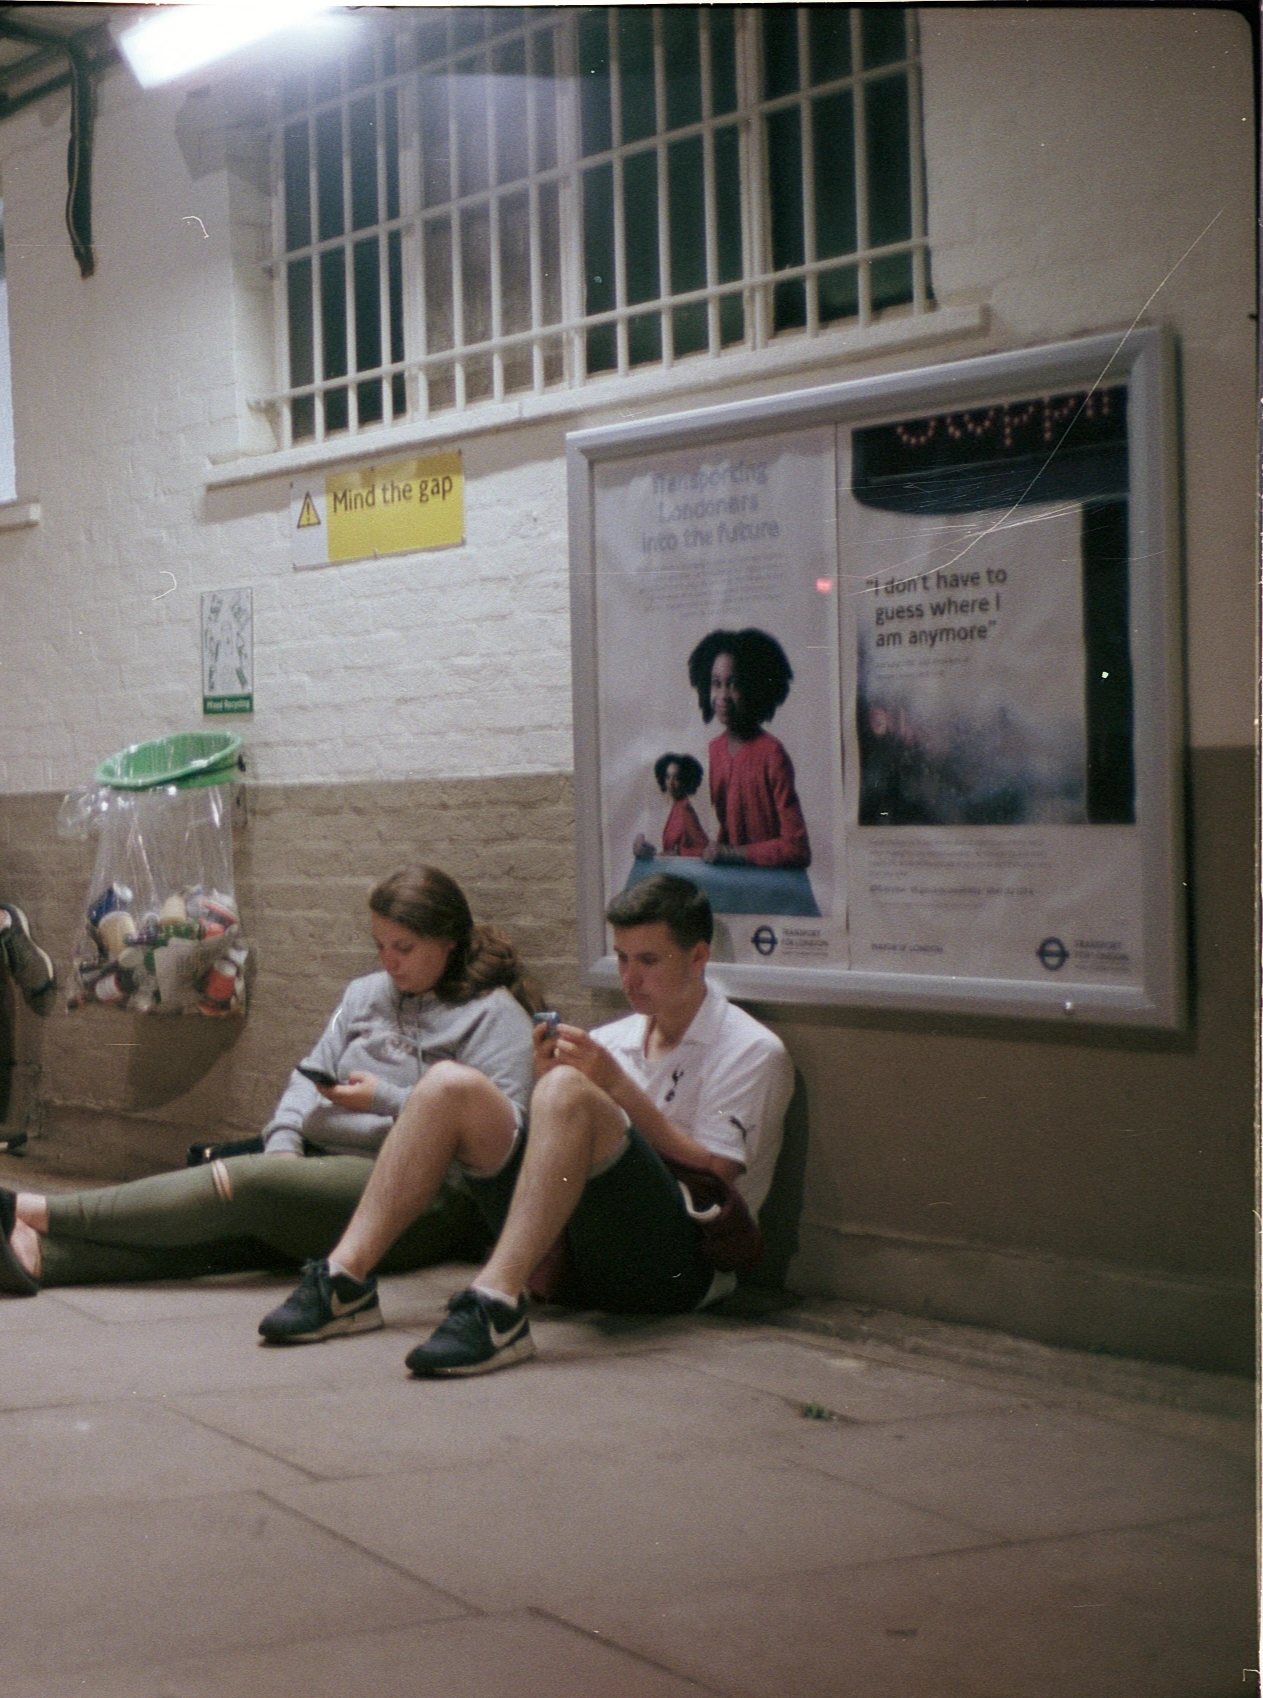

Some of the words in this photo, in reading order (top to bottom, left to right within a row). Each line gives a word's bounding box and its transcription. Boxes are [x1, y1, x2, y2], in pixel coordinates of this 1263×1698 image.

[333, 484, 376, 513] Mind
[382, 480, 413, 504] the
[419, 475, 453, 504] gap
[659, 494, 758, 523] Londoners
[642, 532, 679, 553] into
[683, 526, 713, 548] the
[718, 520, 779, 543] future
[884, 573, 930, 595] don't
[936, 571, 981, 589] have
[986, 568, 1008, 585] to
[875, 602, 924, 626] guess
[930, 597, 990, 617] where
[995, 593, 1001, 611] I
[876, 631, 902, 647] am
